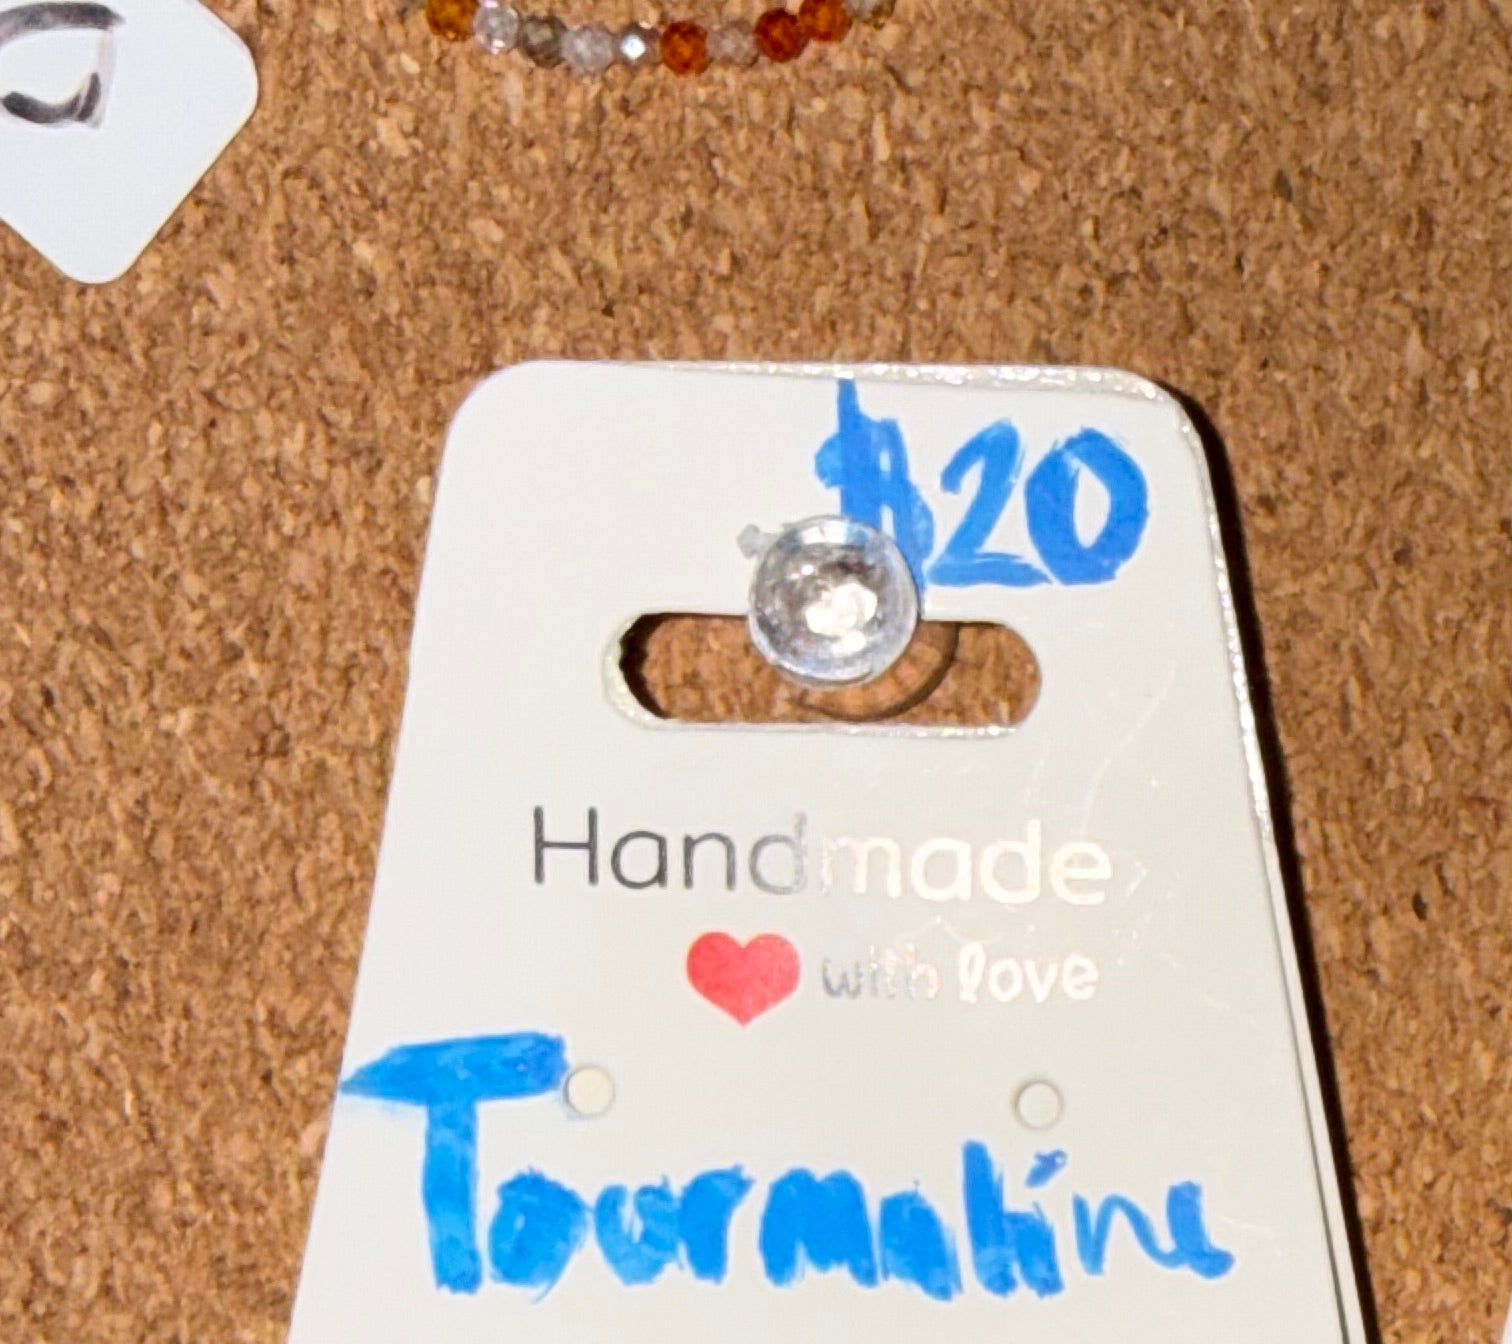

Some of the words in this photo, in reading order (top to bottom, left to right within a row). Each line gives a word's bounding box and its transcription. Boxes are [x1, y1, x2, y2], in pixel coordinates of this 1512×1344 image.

[533, 805, 1114, 906] Handmade
[821, 942, 940, 1001] with
[958, 940, 1100, 1003] love
